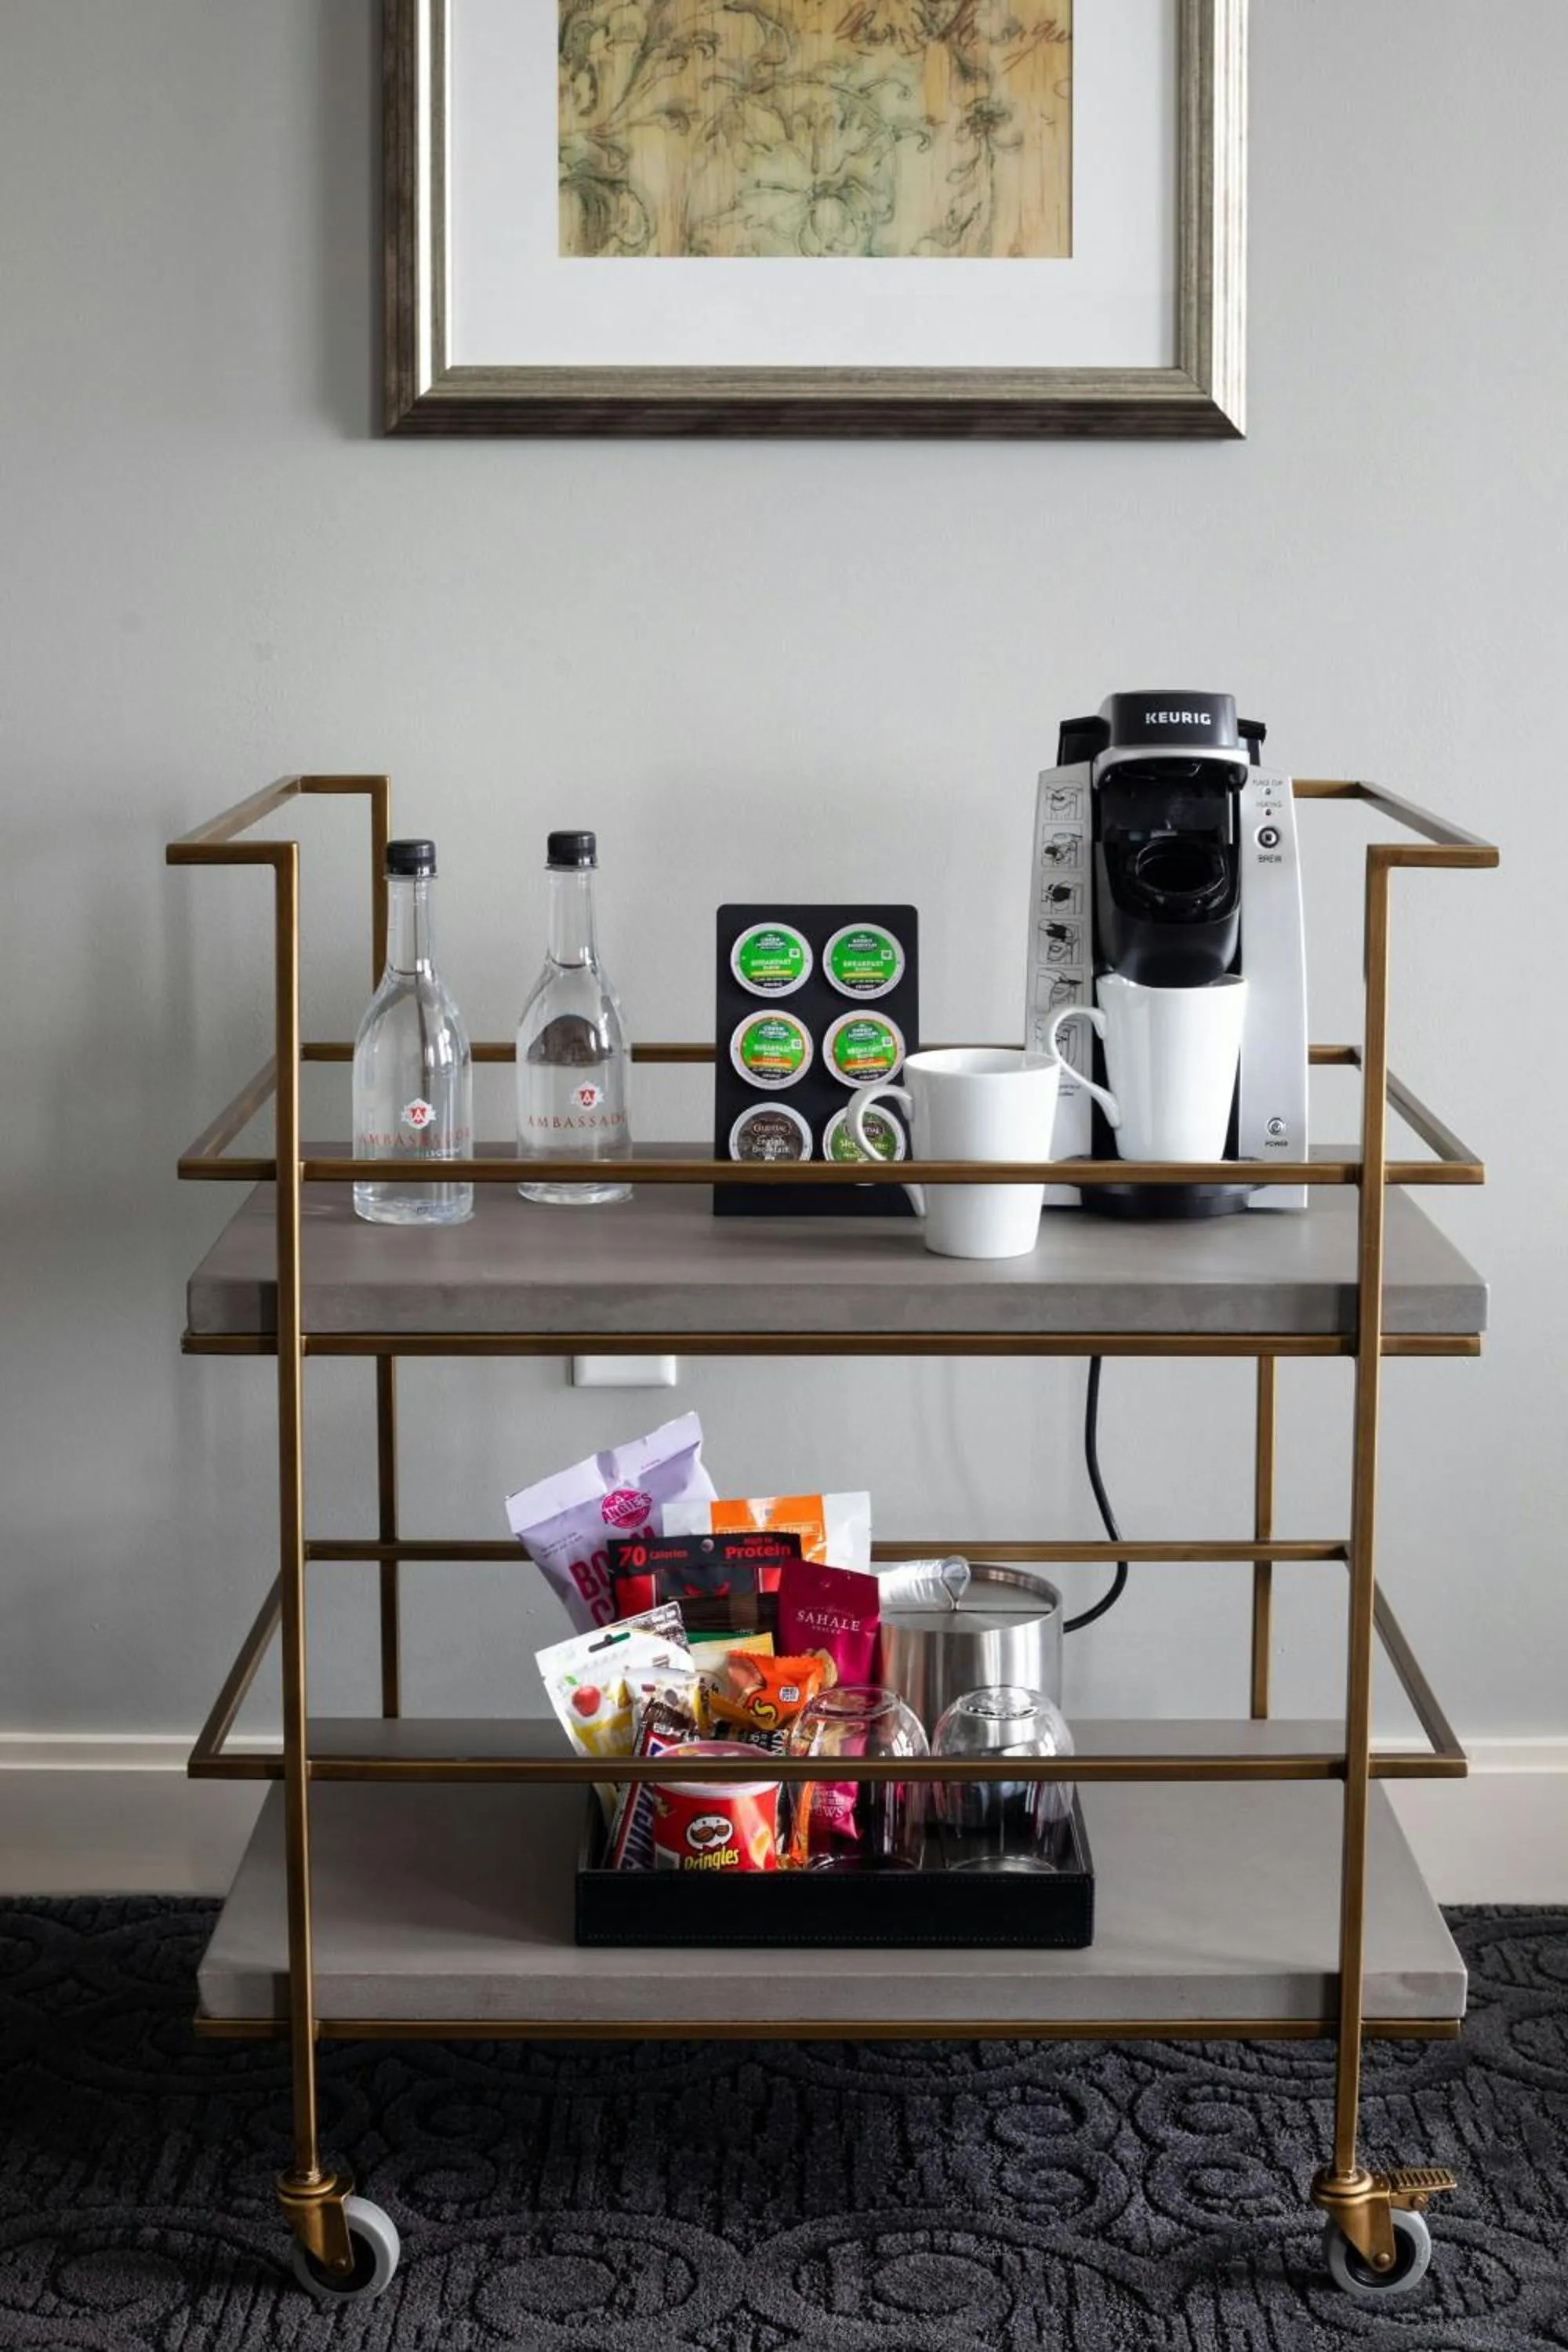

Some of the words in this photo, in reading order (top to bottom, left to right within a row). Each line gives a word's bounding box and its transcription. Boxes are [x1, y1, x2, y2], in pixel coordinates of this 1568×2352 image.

[1145, 711, 1211, 724] KEURIG
[1258, 855, 1282, 863] BREW
[619, 1544, 647, 1566] 70
[726, 1543, 791, 1559] Protein
[797, 1610, 860, 1632] SAHALE
[684, 1845, 739, 1871] Pringles
